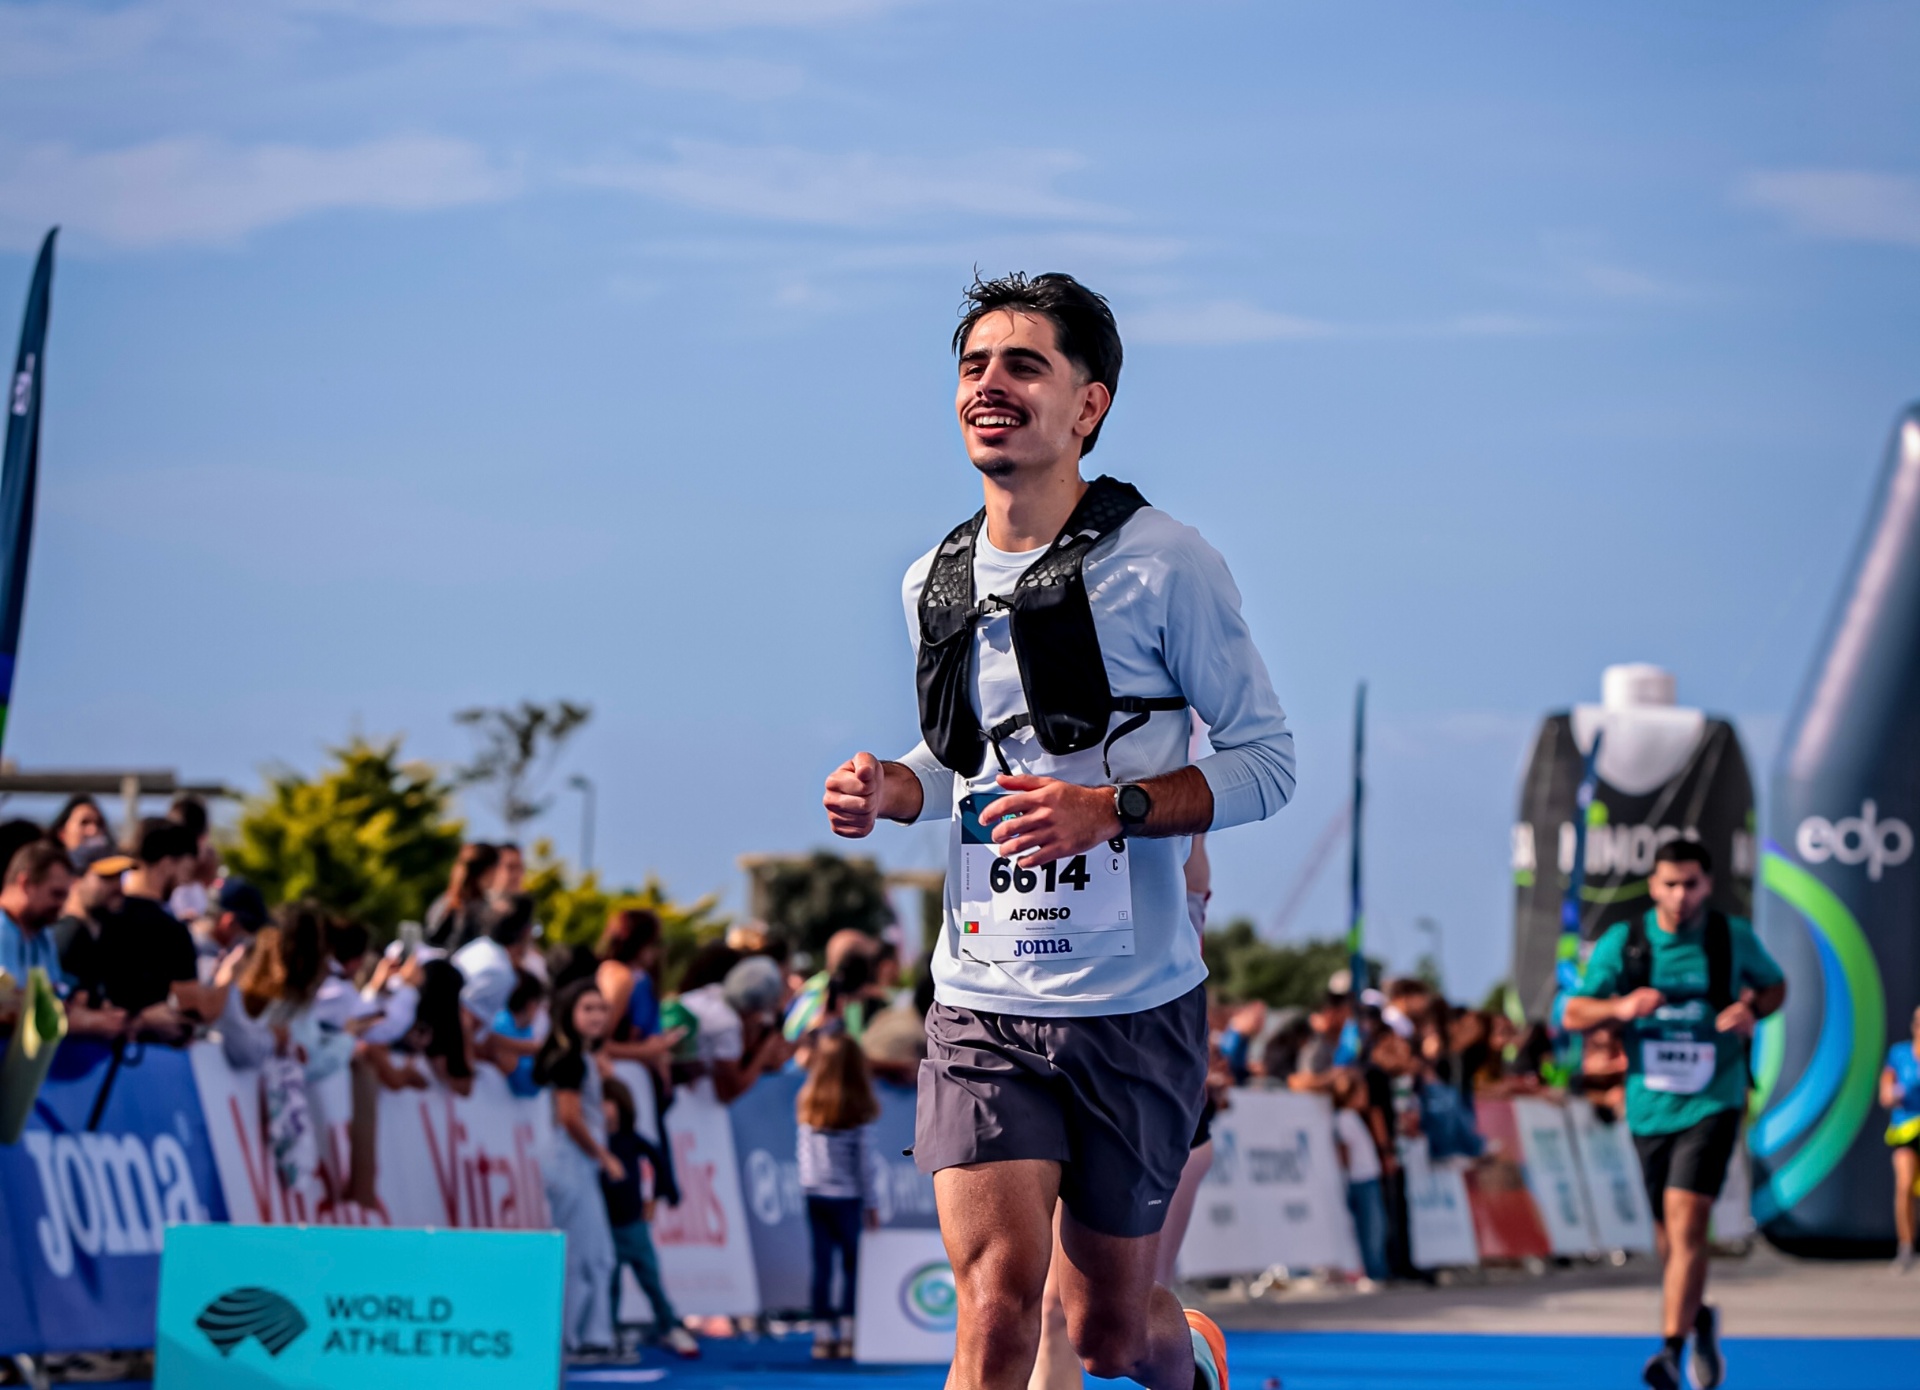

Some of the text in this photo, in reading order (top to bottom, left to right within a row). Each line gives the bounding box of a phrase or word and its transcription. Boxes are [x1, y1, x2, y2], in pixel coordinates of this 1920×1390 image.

[1558, 822, 1700, 876] MIMO
[1795, 798, 1913, 880] edp
[990, 854, 1091, 893] 6614
[1112, 858, 1119, 871] C
[1009, 906, 1071, 921] AFONSO
[419, 1098, 555, 1228] Vitali
[325, 1295, 454, 1323] WORLD
[323, 1328, 513, 1359] ATHLETICS
